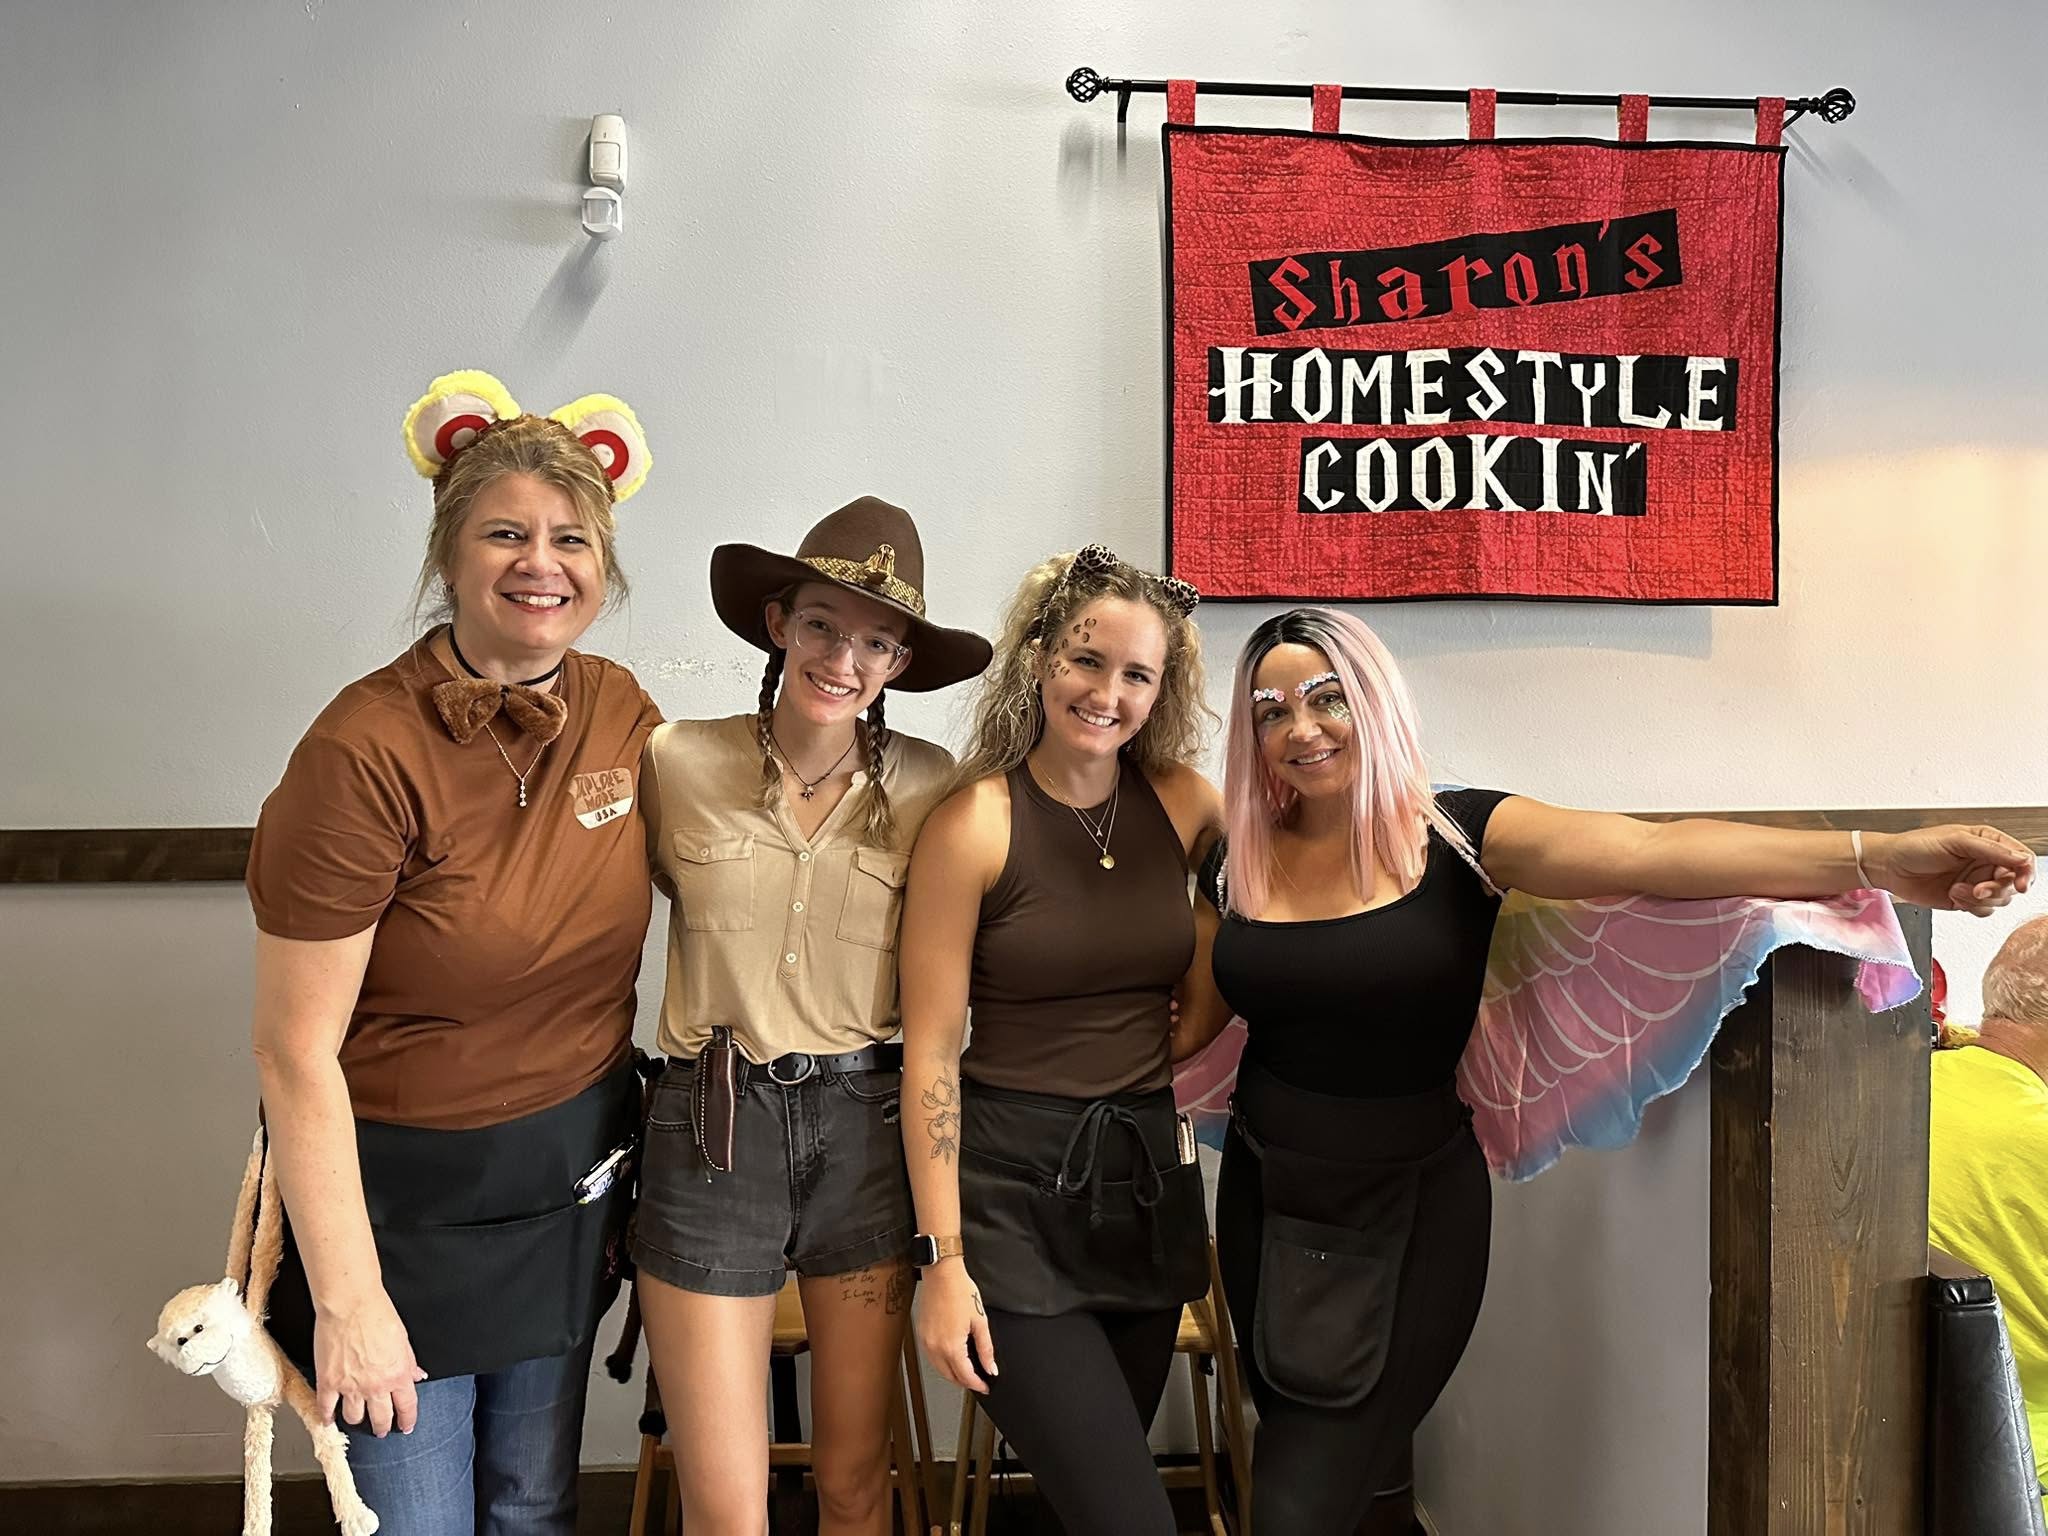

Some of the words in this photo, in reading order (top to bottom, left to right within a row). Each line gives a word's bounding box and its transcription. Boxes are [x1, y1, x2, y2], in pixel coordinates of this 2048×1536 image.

[1268, 218, 1664, 330] Sharon's
[1207, 346, 1727, 431] HOMESTYLE
[1302, 434, 1642, 516] COOKIN'
[583, 788, 620, 811] MORE
[594, 807, 617, 822] USA
